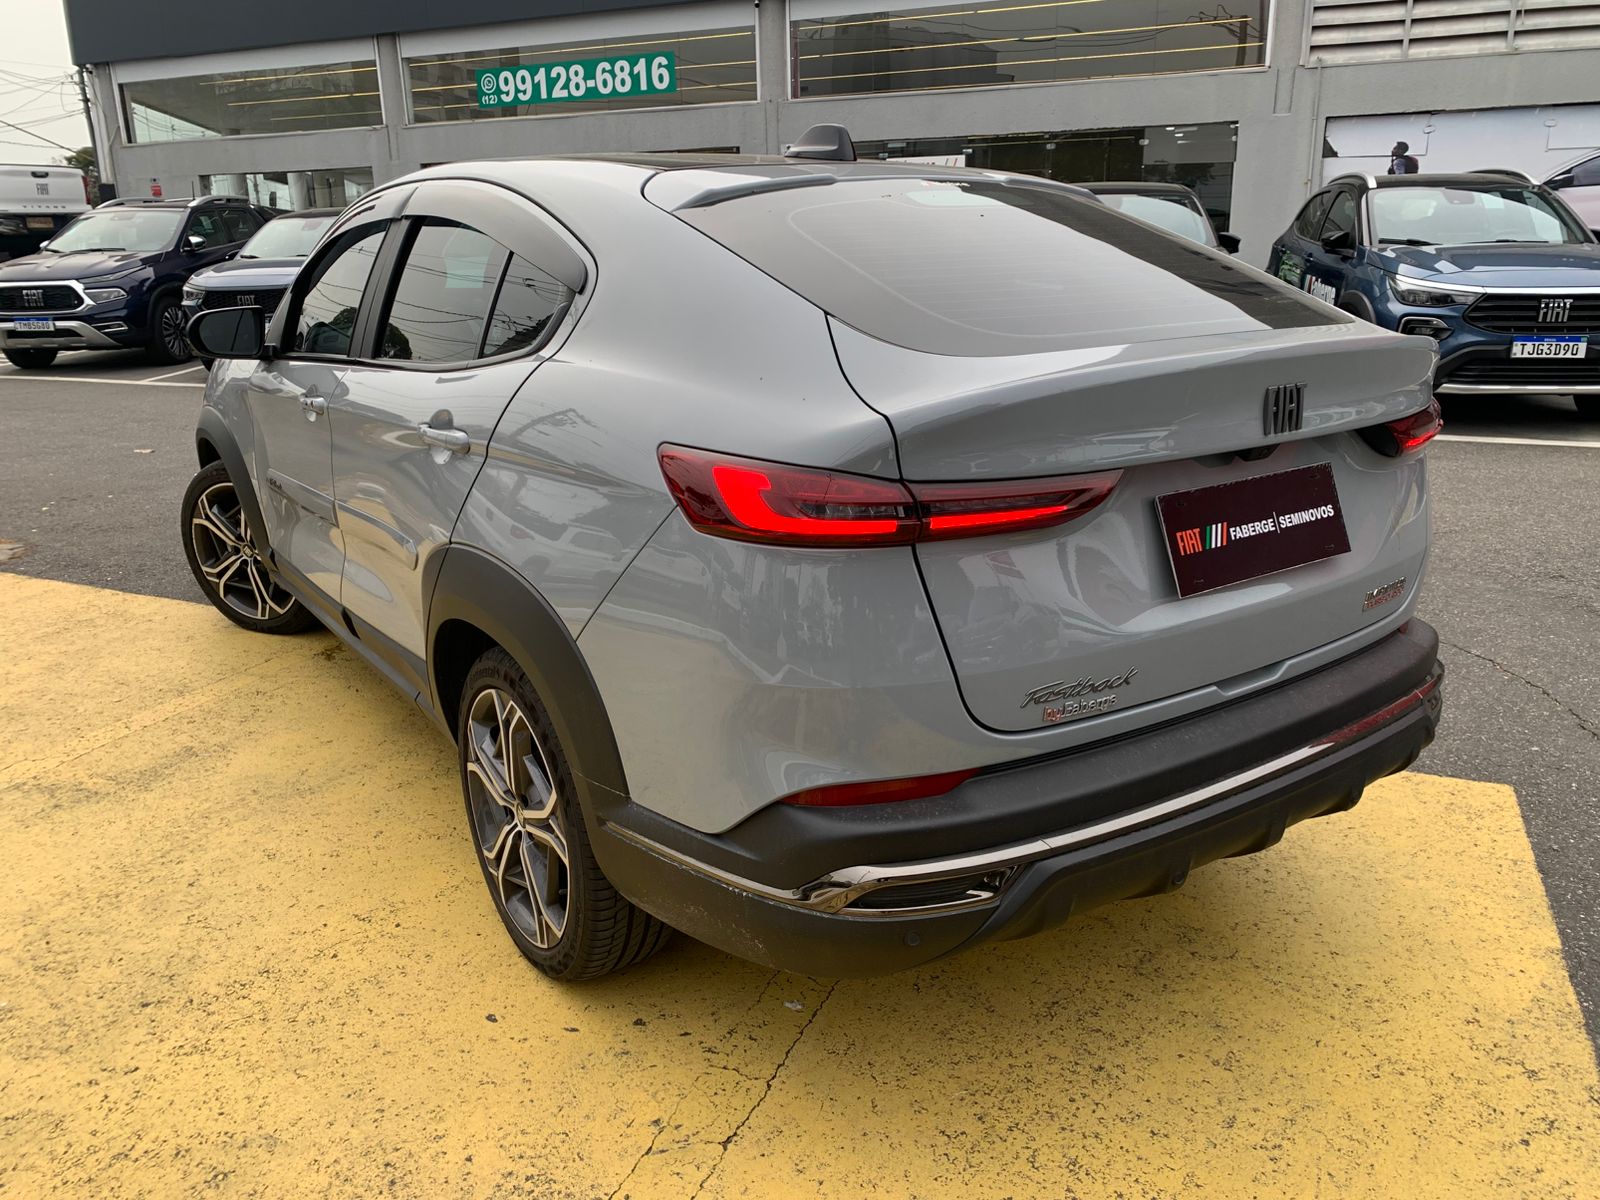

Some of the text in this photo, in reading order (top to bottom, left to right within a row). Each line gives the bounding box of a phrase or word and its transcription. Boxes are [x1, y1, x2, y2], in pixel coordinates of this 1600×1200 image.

[498, 56, 670, 102] 99128-6816
[482, 95, 498, 104] (12)
[22, 289, 44, 307] FIAT
[237, 295, 255, 306] FIAT
[1538, 298, 1574, 322] FIAT
[1520, 343, 1580, 356] TJG3D90
[1262, 382, 1308, 436] FIAT
[1176, 504, 1335, 556] FIAT FABERGE SEMINOVOS
[1020, 665, 1139, 709] Fastback
